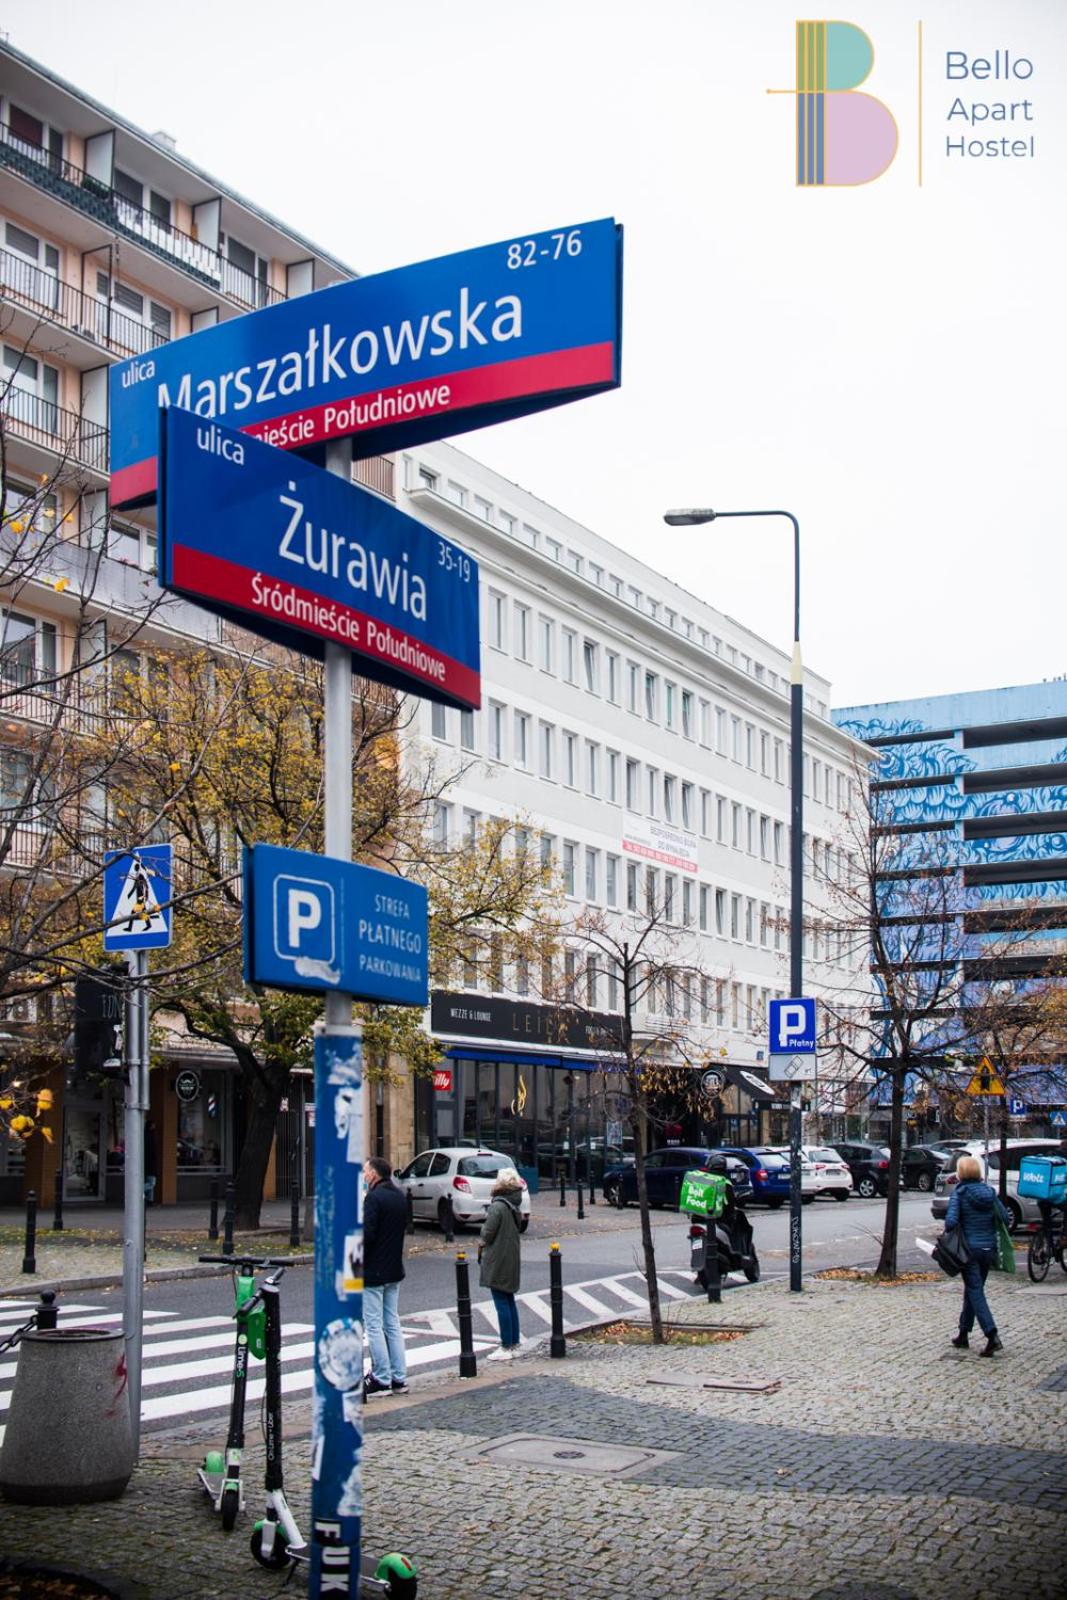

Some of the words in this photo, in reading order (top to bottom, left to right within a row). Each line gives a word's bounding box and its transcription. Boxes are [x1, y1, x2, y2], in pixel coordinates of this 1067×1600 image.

[506, 229, 583, 270] 82-76
[121, 357, 156, 389] ulica
[157, 287, 523, 418] Marszałkowska
[323, 382, 451, 434] Południowe
[196, 425, 245, 466] ulica
[278, 480, 428, 622] Żurawia
[438, 541, 472, 584] 35-19
[251, 574, 360, 642] Śródmieście
[366, 622, 447, 683] Południowe
[288, 888, 322, 949] P
[374, 894, 411, 920] STREFA
[359, 919, 422, 955] PŁATNEGO
[359, 953, 421, 983] PARKOWANIA
[779, 1004, 807, 1048] P
[685, 1195, 708, 1209] Food
